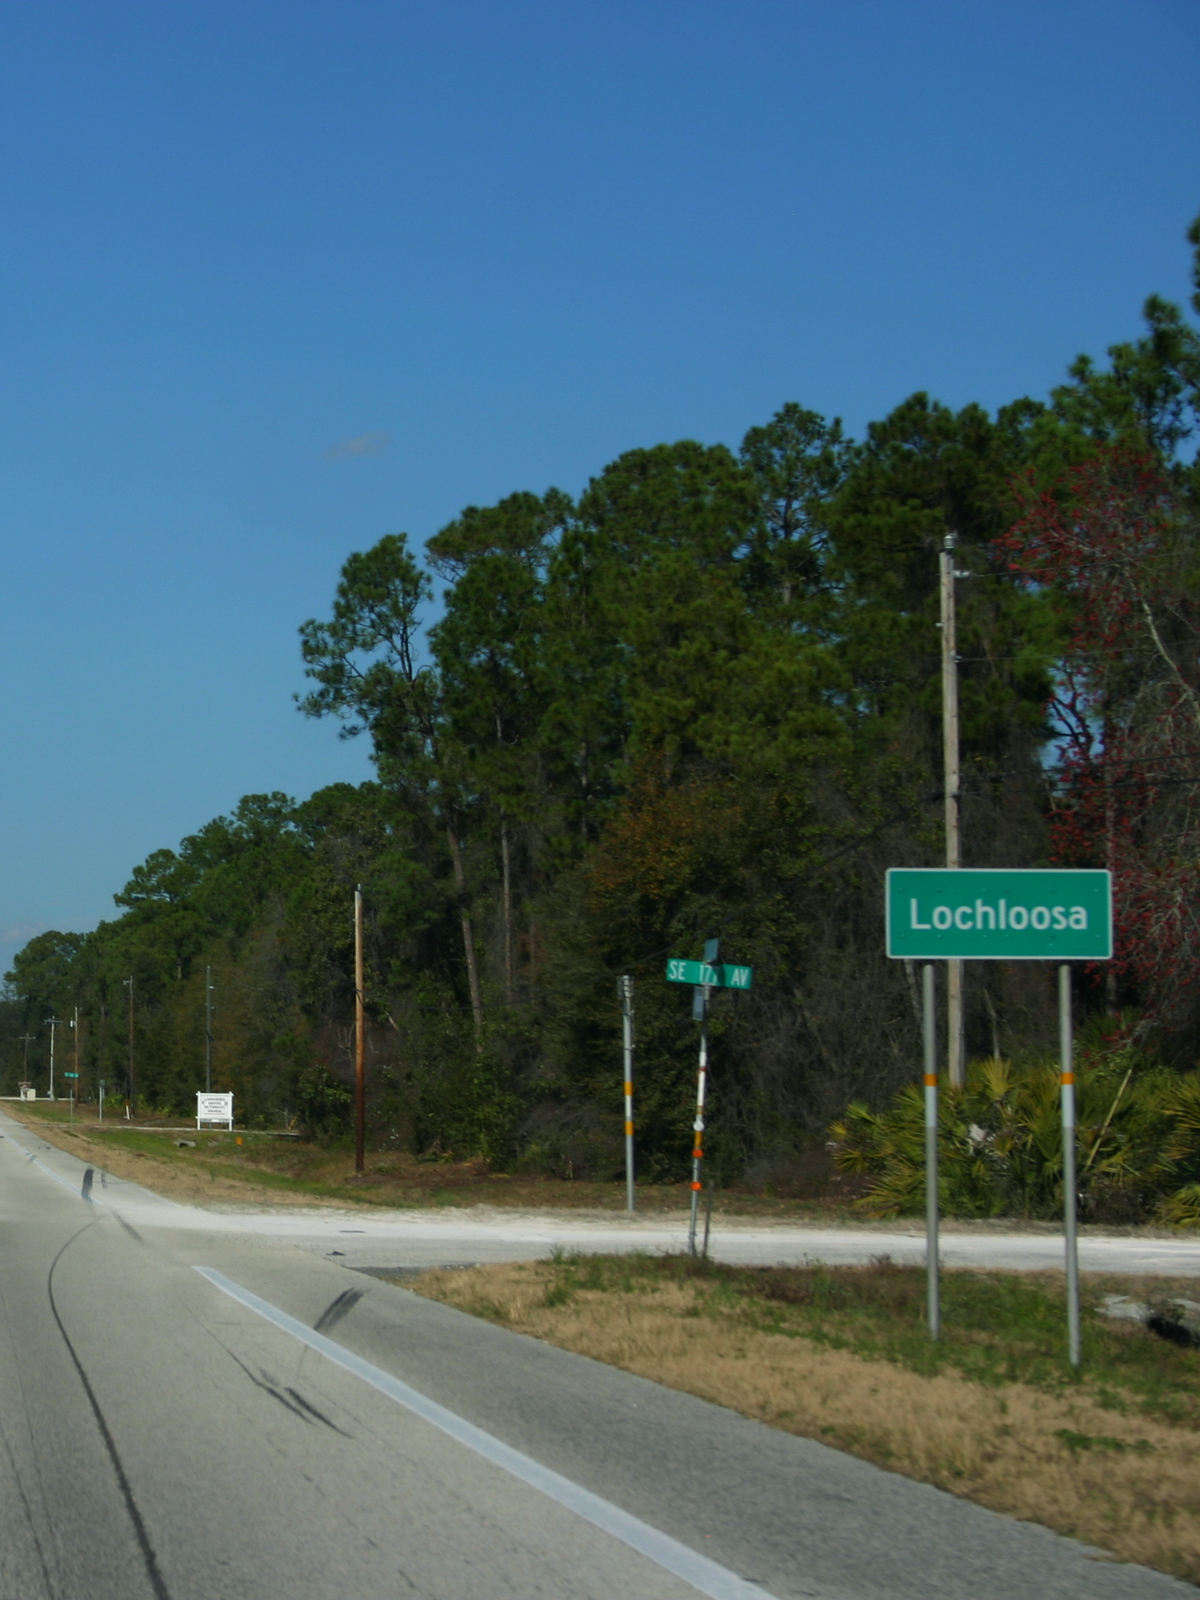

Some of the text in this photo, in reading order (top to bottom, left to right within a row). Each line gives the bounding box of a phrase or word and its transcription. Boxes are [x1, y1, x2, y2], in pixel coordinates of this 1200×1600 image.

[910, 898, 1088, 930] Lochloosa
[668, 961, 687, 980] SE
[730, 967, 749, 986] AV
